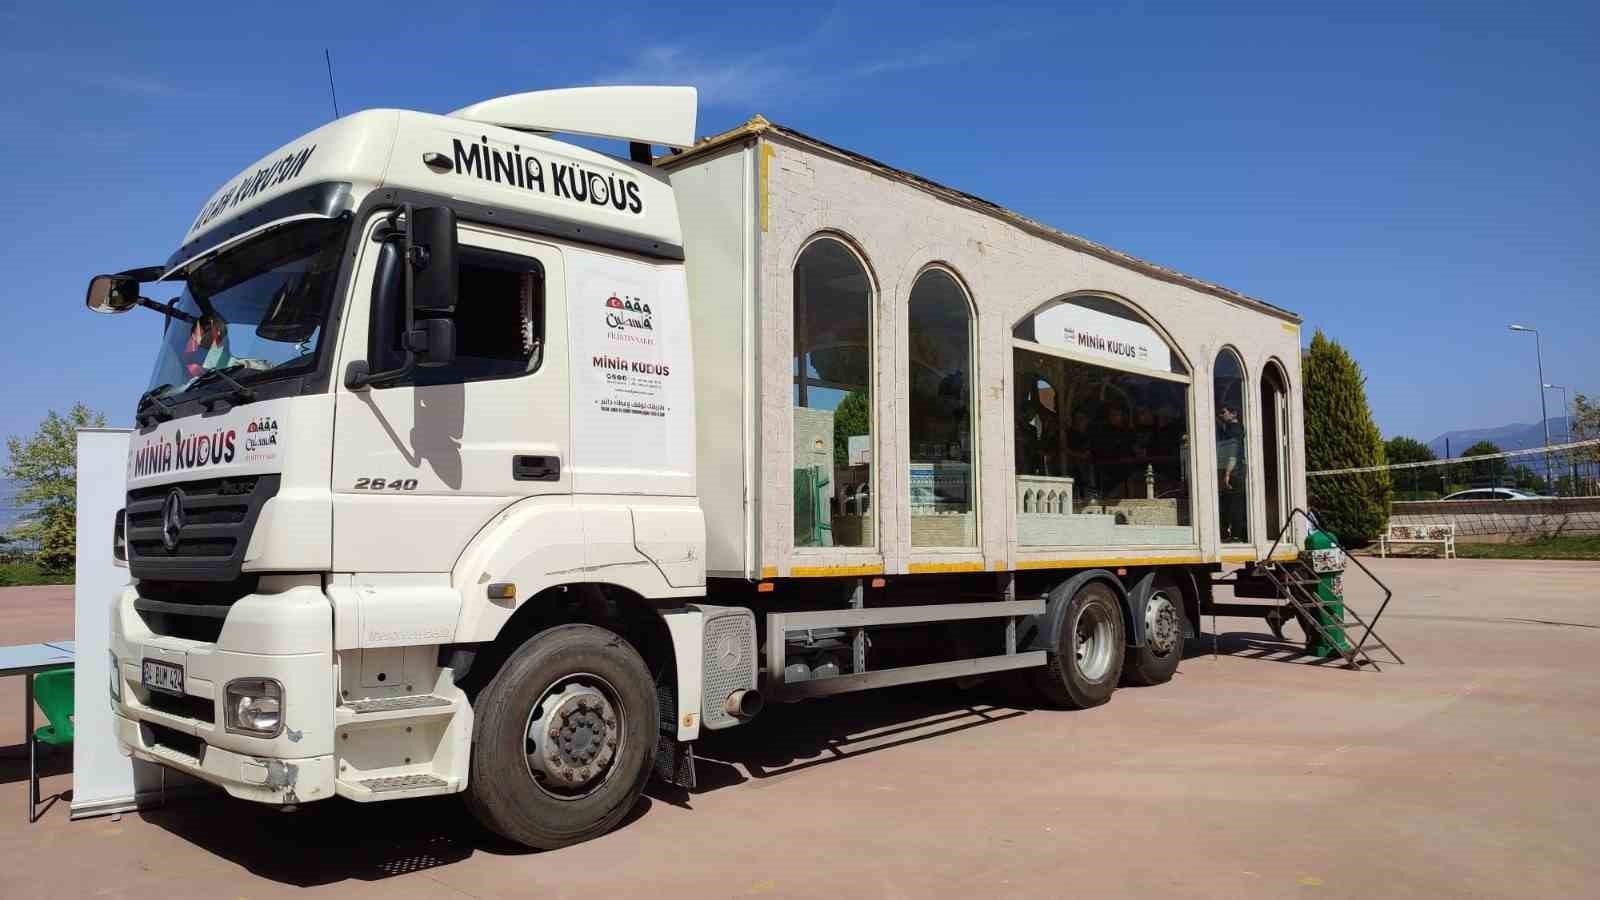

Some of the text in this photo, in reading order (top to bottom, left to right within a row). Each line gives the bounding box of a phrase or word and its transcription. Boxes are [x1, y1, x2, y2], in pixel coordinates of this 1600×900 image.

[453, 135, 643, 214] MİNİA KÜDÜS
[592, 354, 628, 371] MİNİA
[134, 436, 171, 478] MİNİA
[175, 427, 236, 471] KÜDÜS
[354, 477, 419, 491] 2640
